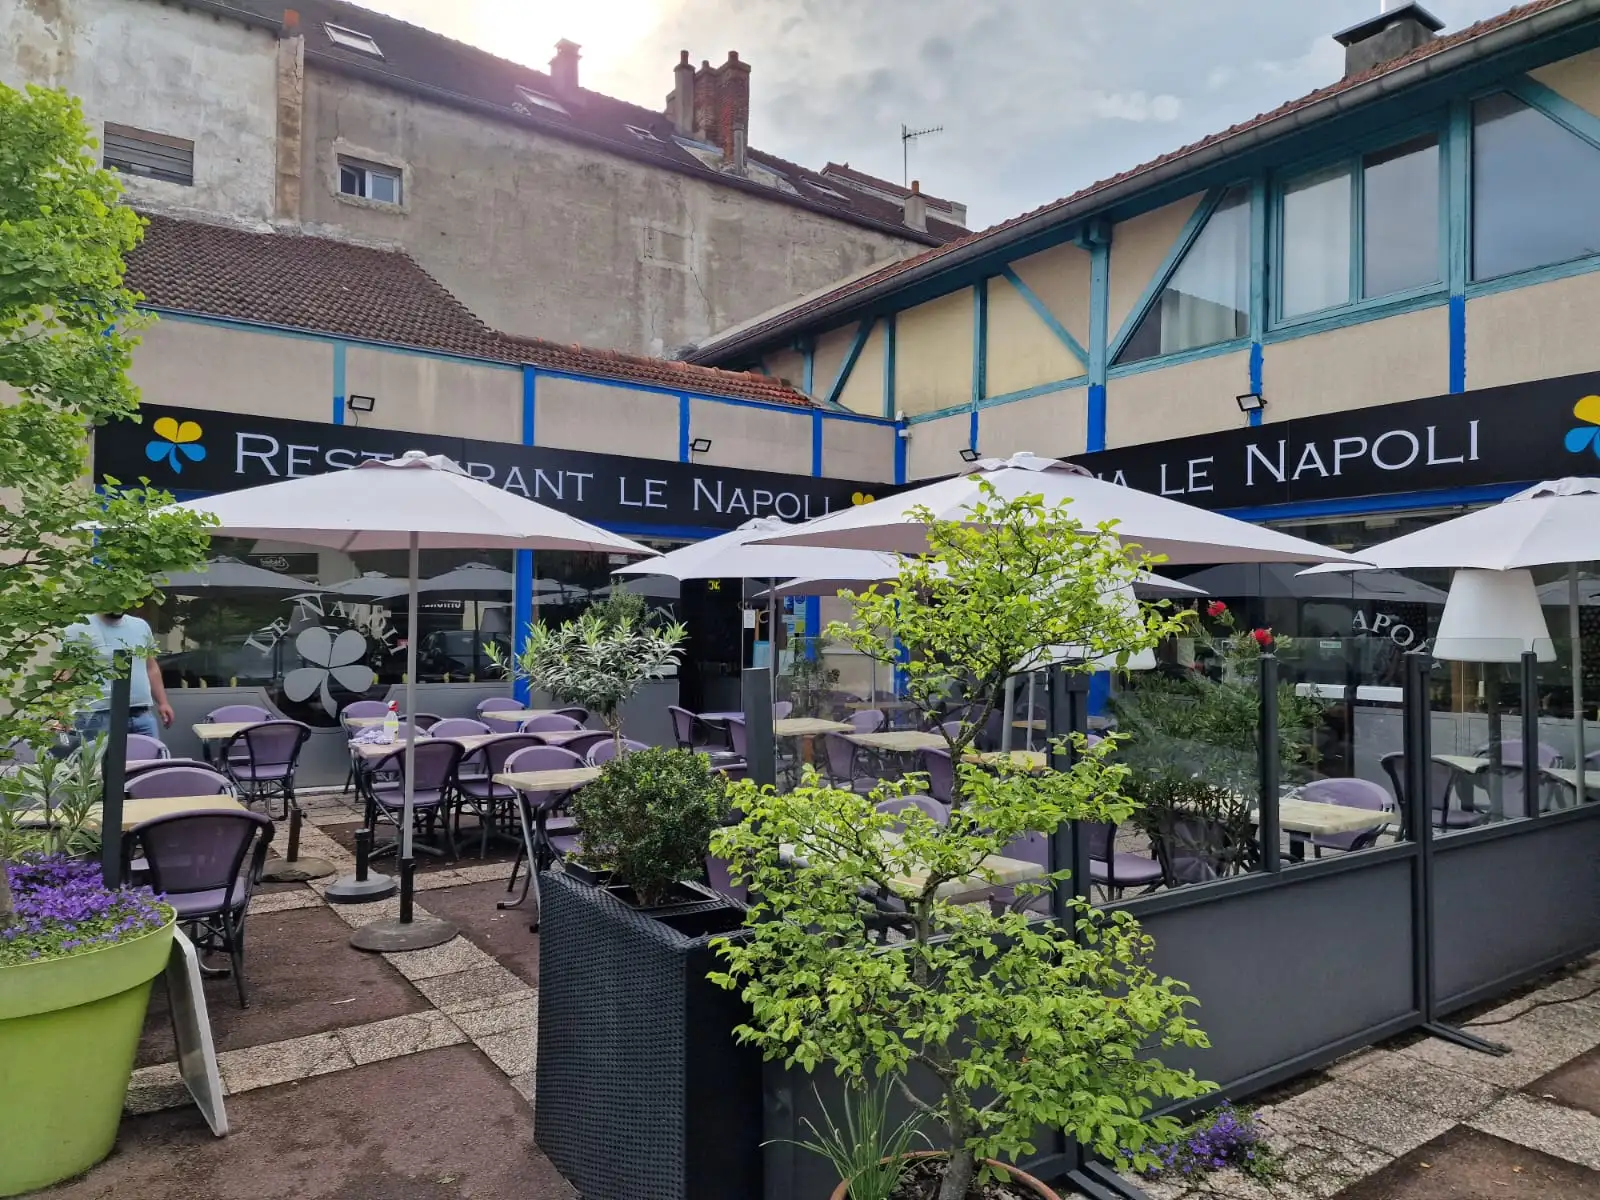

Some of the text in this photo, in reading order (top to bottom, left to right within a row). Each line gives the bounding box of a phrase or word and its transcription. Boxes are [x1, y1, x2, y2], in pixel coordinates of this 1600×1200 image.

[1160, 420, 1480, 496] LE NAPOLI
[619, 476, 668, 509] LE
[693, 478, 831, 520] NAPOLI
